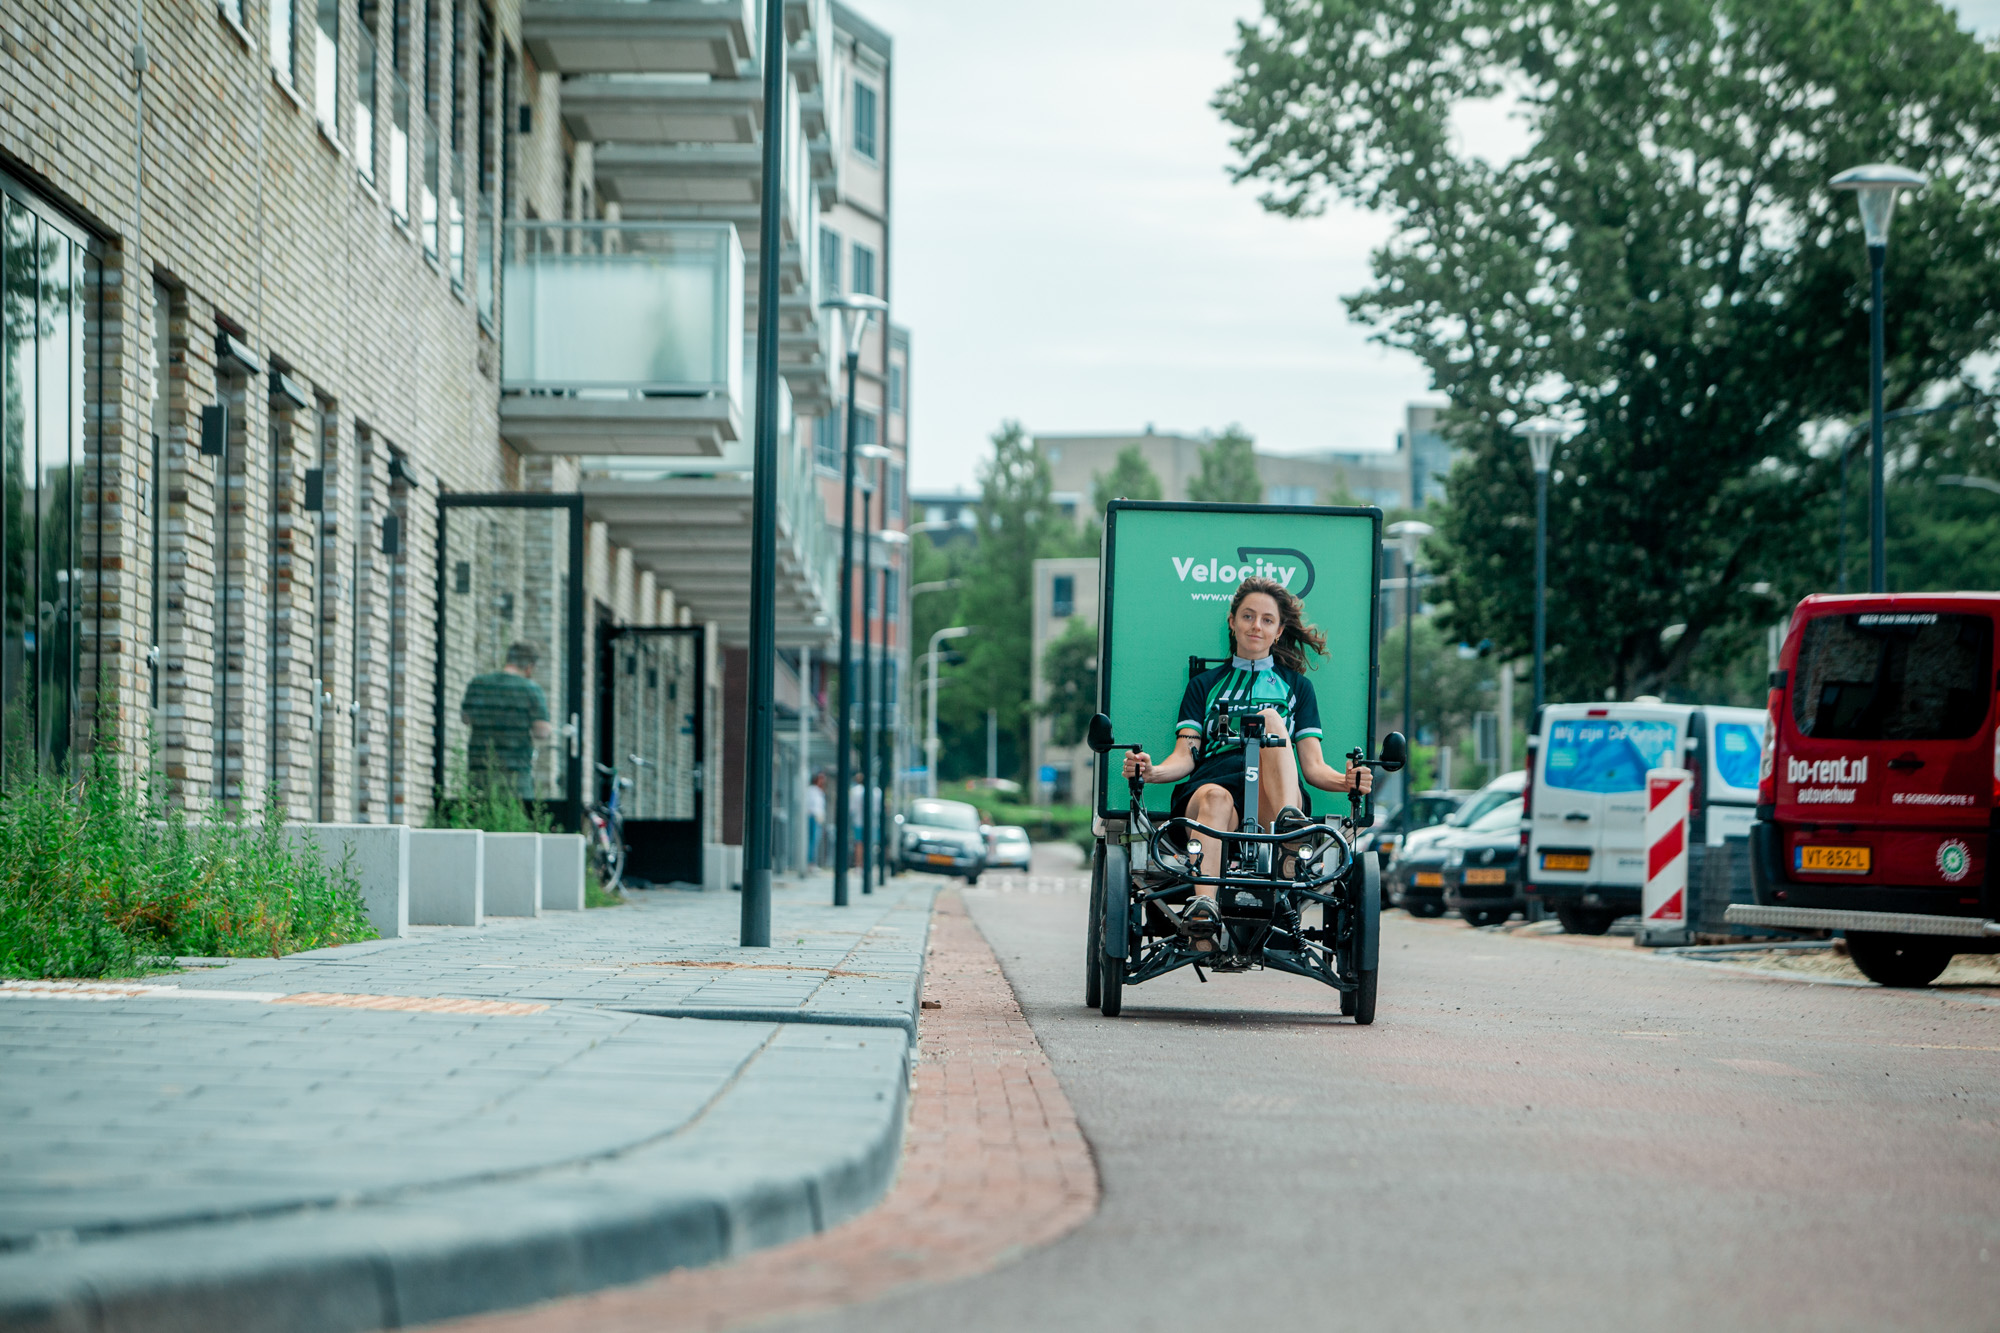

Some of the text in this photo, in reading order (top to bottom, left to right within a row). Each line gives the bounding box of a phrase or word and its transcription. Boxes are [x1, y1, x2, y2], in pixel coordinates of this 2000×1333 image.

[1171, 556, 1297, 588] Velocity
[1190, 592, 1237, 602] www.ve
[1245, 766, 1259, 782] 5
[1787, 754, 1869, 784] bo-rent.nl
[1797, 784, 1857, 804] autoverhuur
[1806, 848, 1865, 867] VT-852-L
